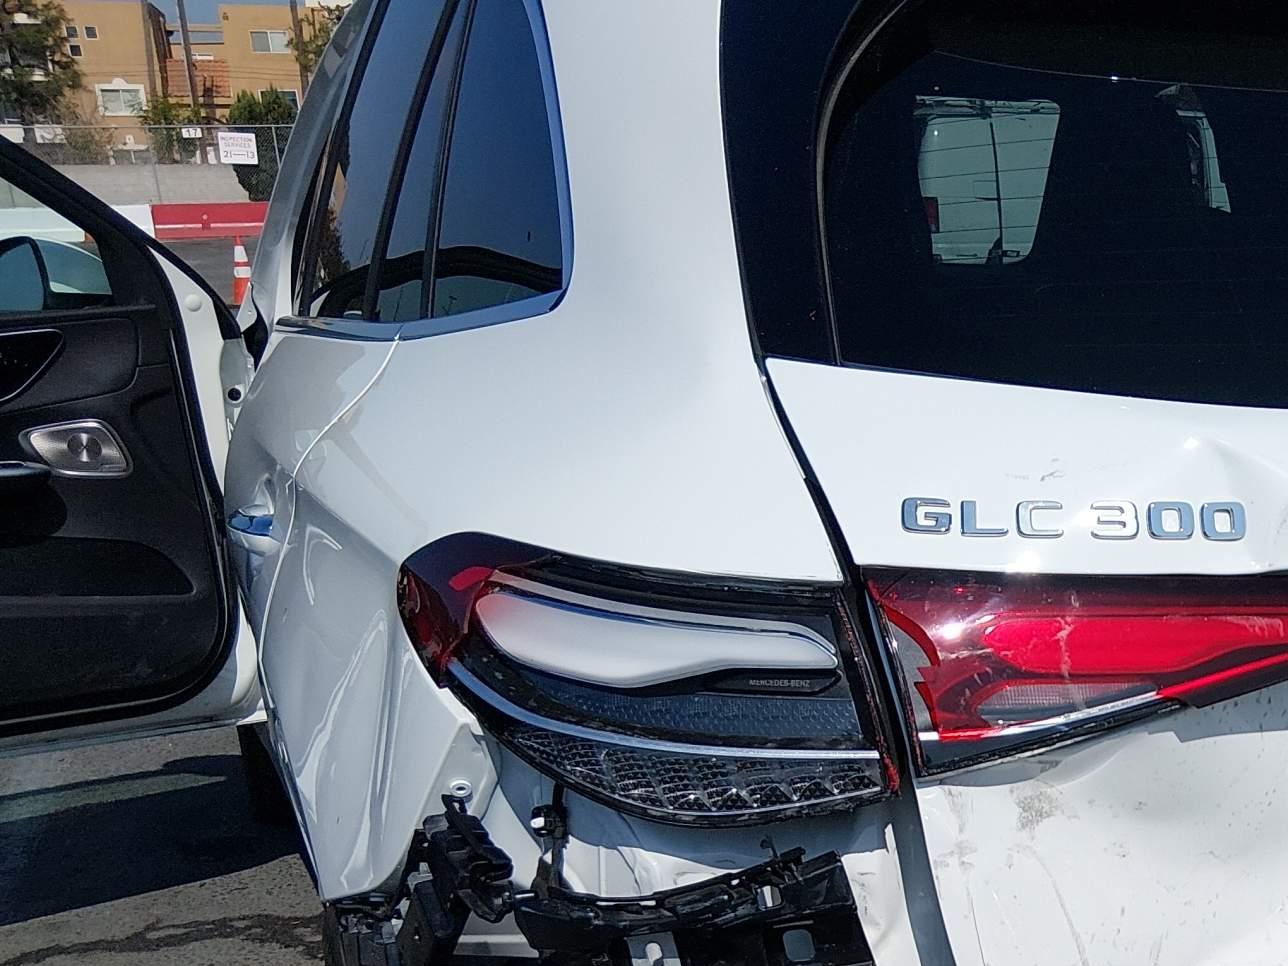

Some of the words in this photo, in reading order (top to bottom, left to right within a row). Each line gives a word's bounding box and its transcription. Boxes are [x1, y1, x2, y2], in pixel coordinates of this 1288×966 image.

[901, 497, 1064, 538] GLC
[1090, 500, 1247, 542] 300
[749, 679, 810, 688] MERCEDES-BENZ
